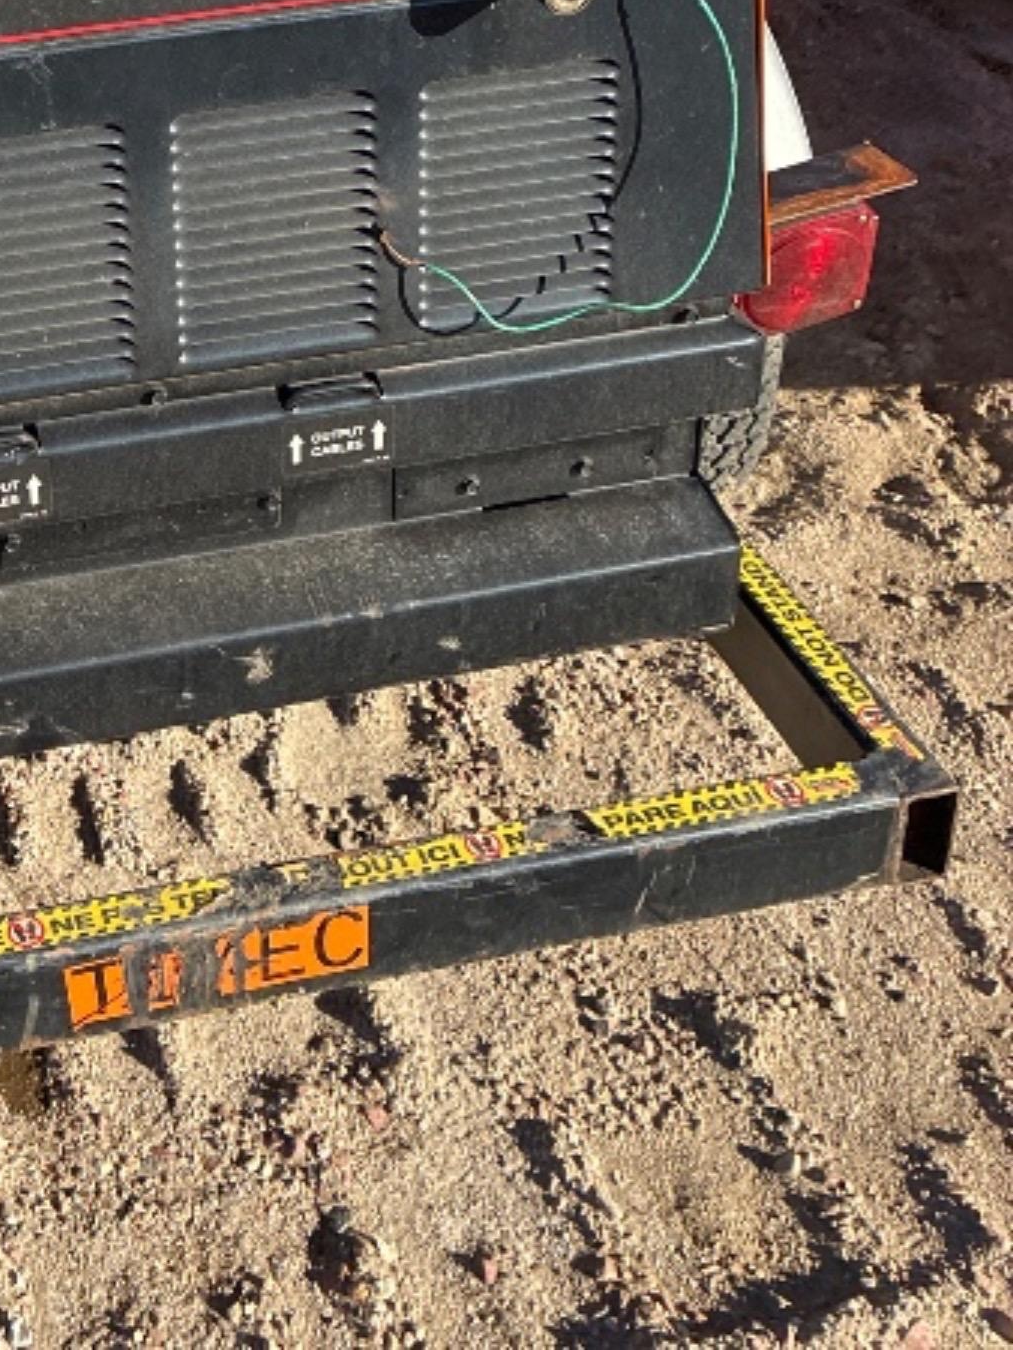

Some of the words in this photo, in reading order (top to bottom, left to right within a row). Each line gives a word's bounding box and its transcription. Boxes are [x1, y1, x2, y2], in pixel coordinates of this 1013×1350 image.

[310, 425, 366, 445] OUTPUT
[602, 803, 689, 829] PARE
[419, 843, 461, 864] ICI
[50, 912, 96, 934] NE
[70, 911, 365, 1015] TEC
